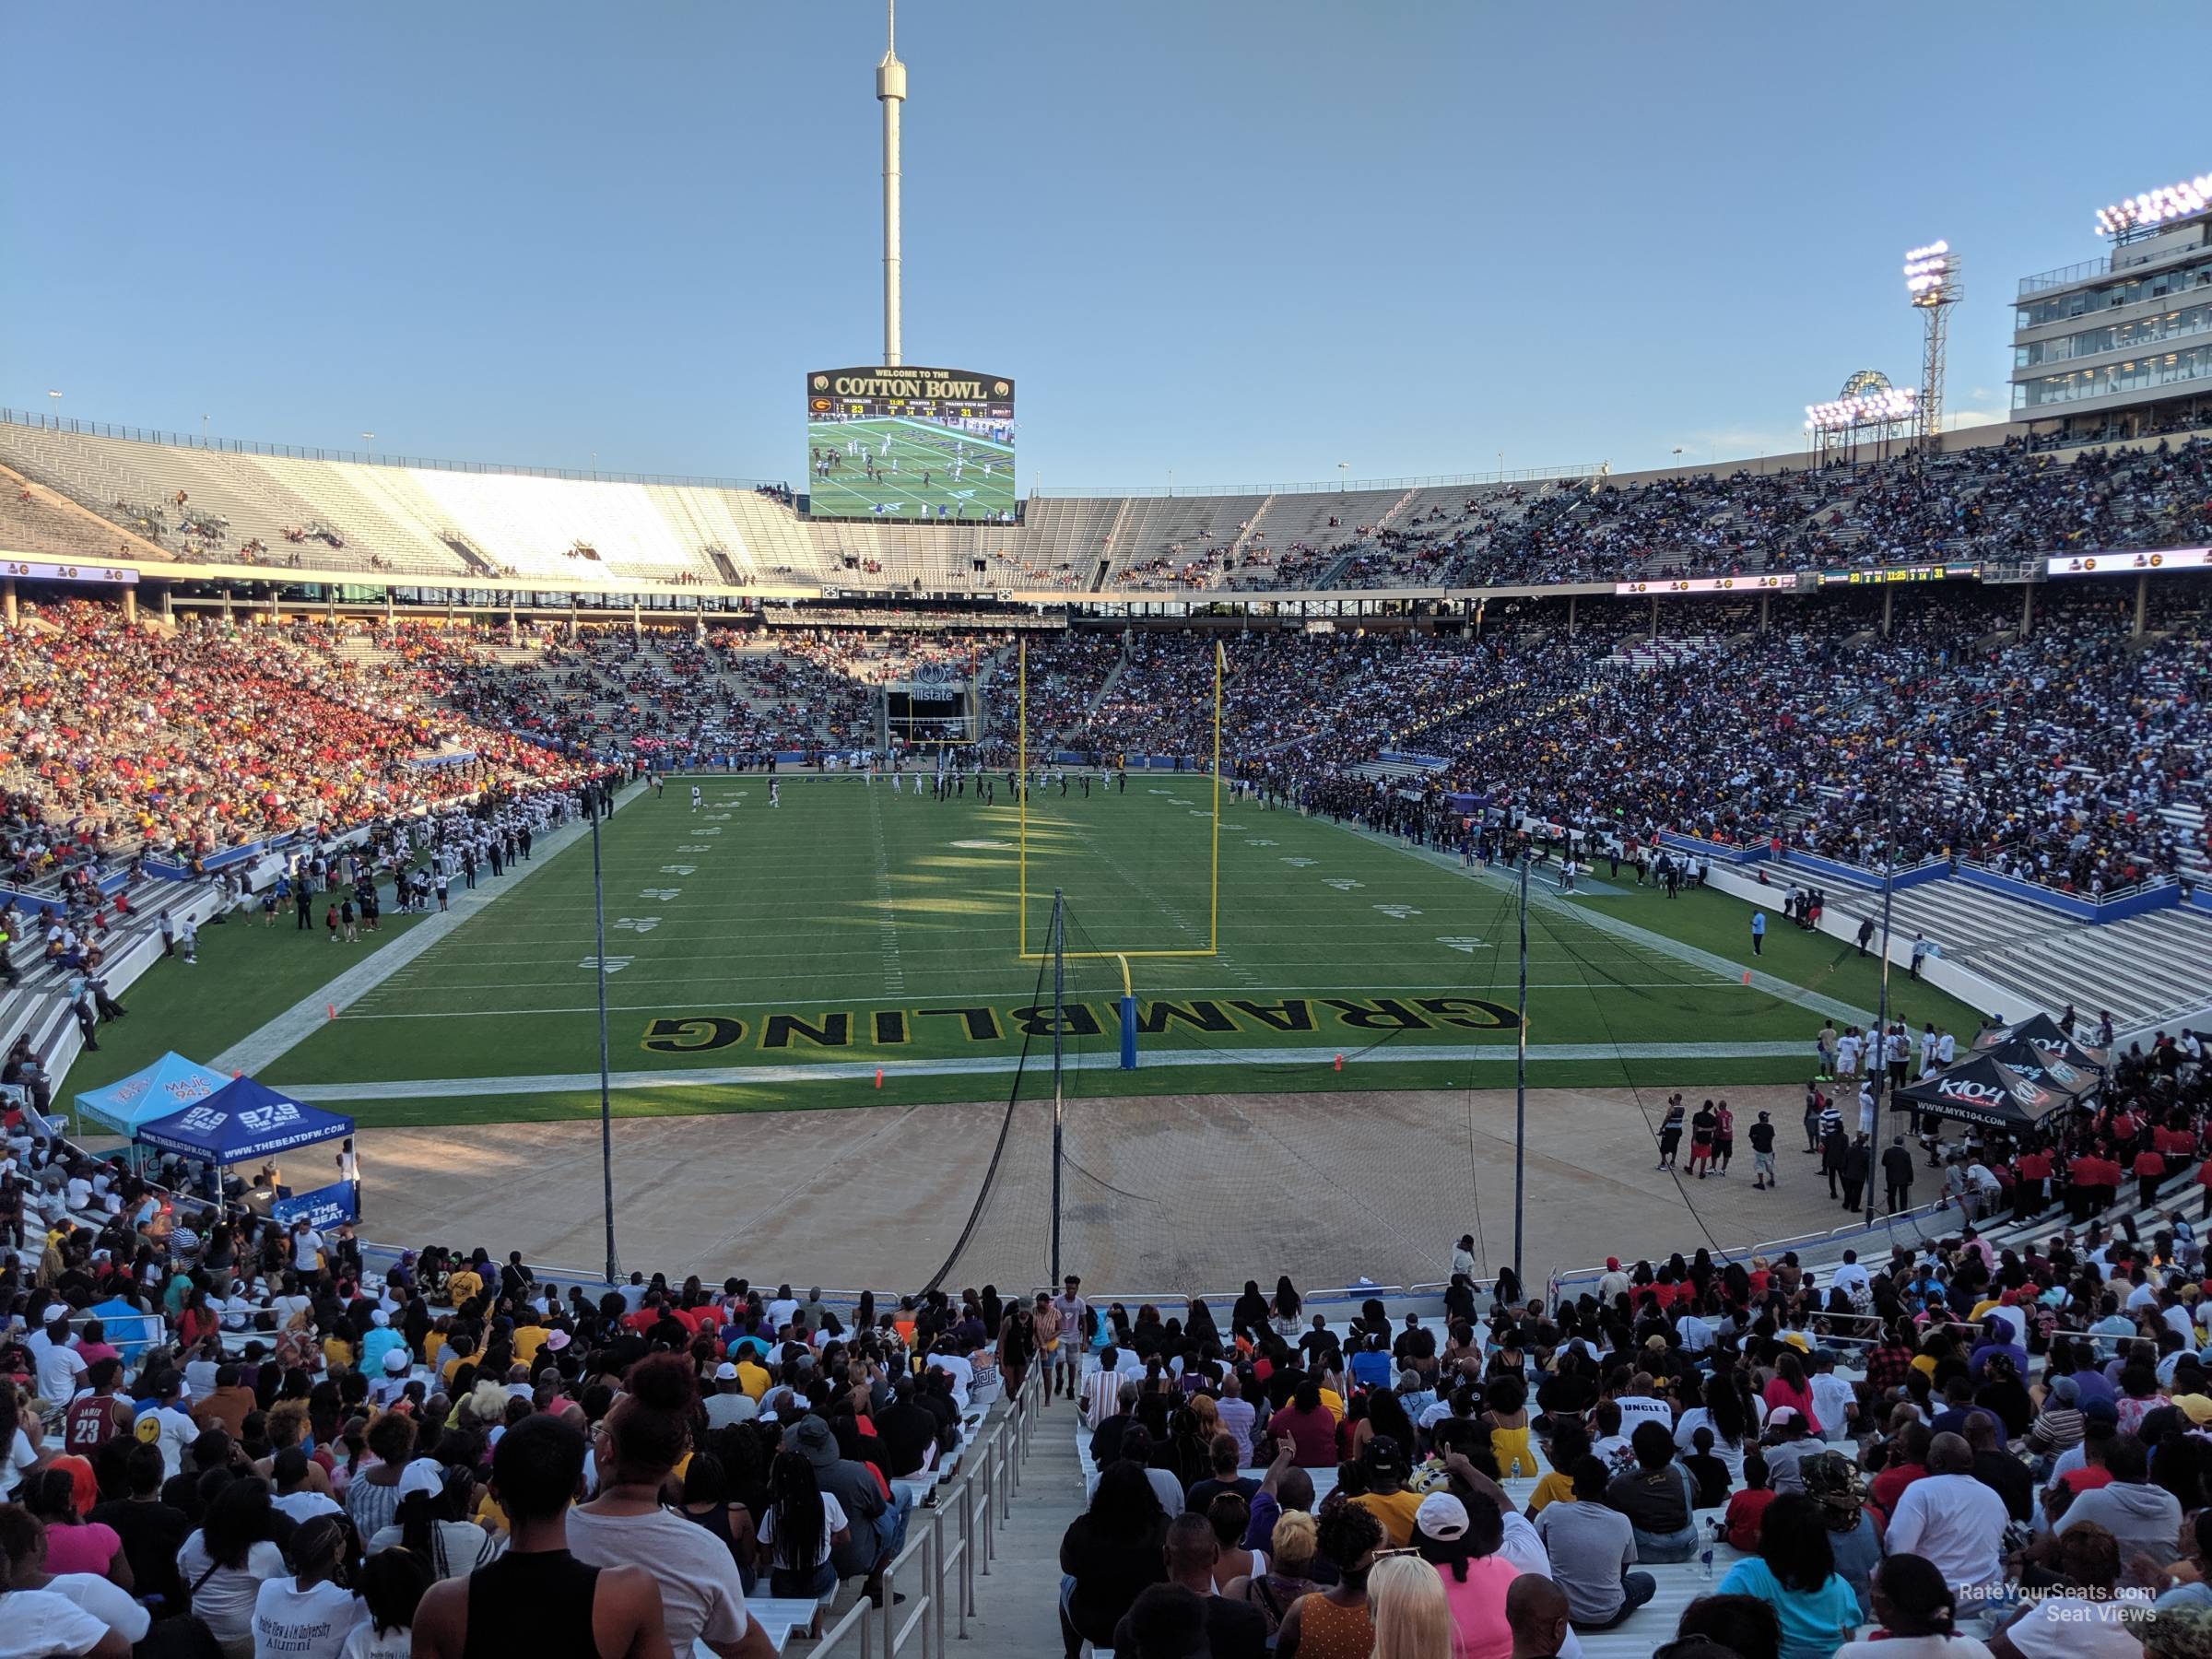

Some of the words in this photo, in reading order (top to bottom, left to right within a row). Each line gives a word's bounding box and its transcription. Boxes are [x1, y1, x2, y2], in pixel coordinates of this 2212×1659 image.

[875, 369, 918, 378] WELCOME
[835, 377, 922, 397] COTTON
[924, 380, 987, 399] BOWL
[852, 405, 864, 414] 23
[960, 408, 972, 417] 31
[1850, 573, 1860, 582] 23
[1887, 571, 1907, 581] 11:25
[1934, 568, 1944, 578] 31
[824, 588, 837, 597] 25
[999, 590, 1012, 599] 25
[908, 689, 953, 701] Allstate
[641, 998, 1530, 1053] GRAMBLING
[175, 1088, 211, 1101] 94.5
[1937, 1078, 2006, 1104] K104
[186, 1106, 229, 1125] 97.9
[238, 1103, 300, 1124] 97.9
[1917, 1100, 2006, 1127] WWW.MYK104.COM
[246, 1119, 272, 1129] THE
[273, 1113, 301, 1122] BEAT
[139, 1131, 212, 1159] WWW.THEBEATDFW.COM
[224, 1123, 346, 1159] WWW.THEBEATDFW.COM
[312, 1202, 338, 1217] THE
[312, 1209, 344, 1226] BEAT
[79, 1407, 102, 1418] JAMES
[1624, 1404, 1660, 1412] UNCLE
[74, 1419, 100, 1444] 23
[299, 1621, 331, 1640] University
[265, 1638, 312, 1652] Alumni
